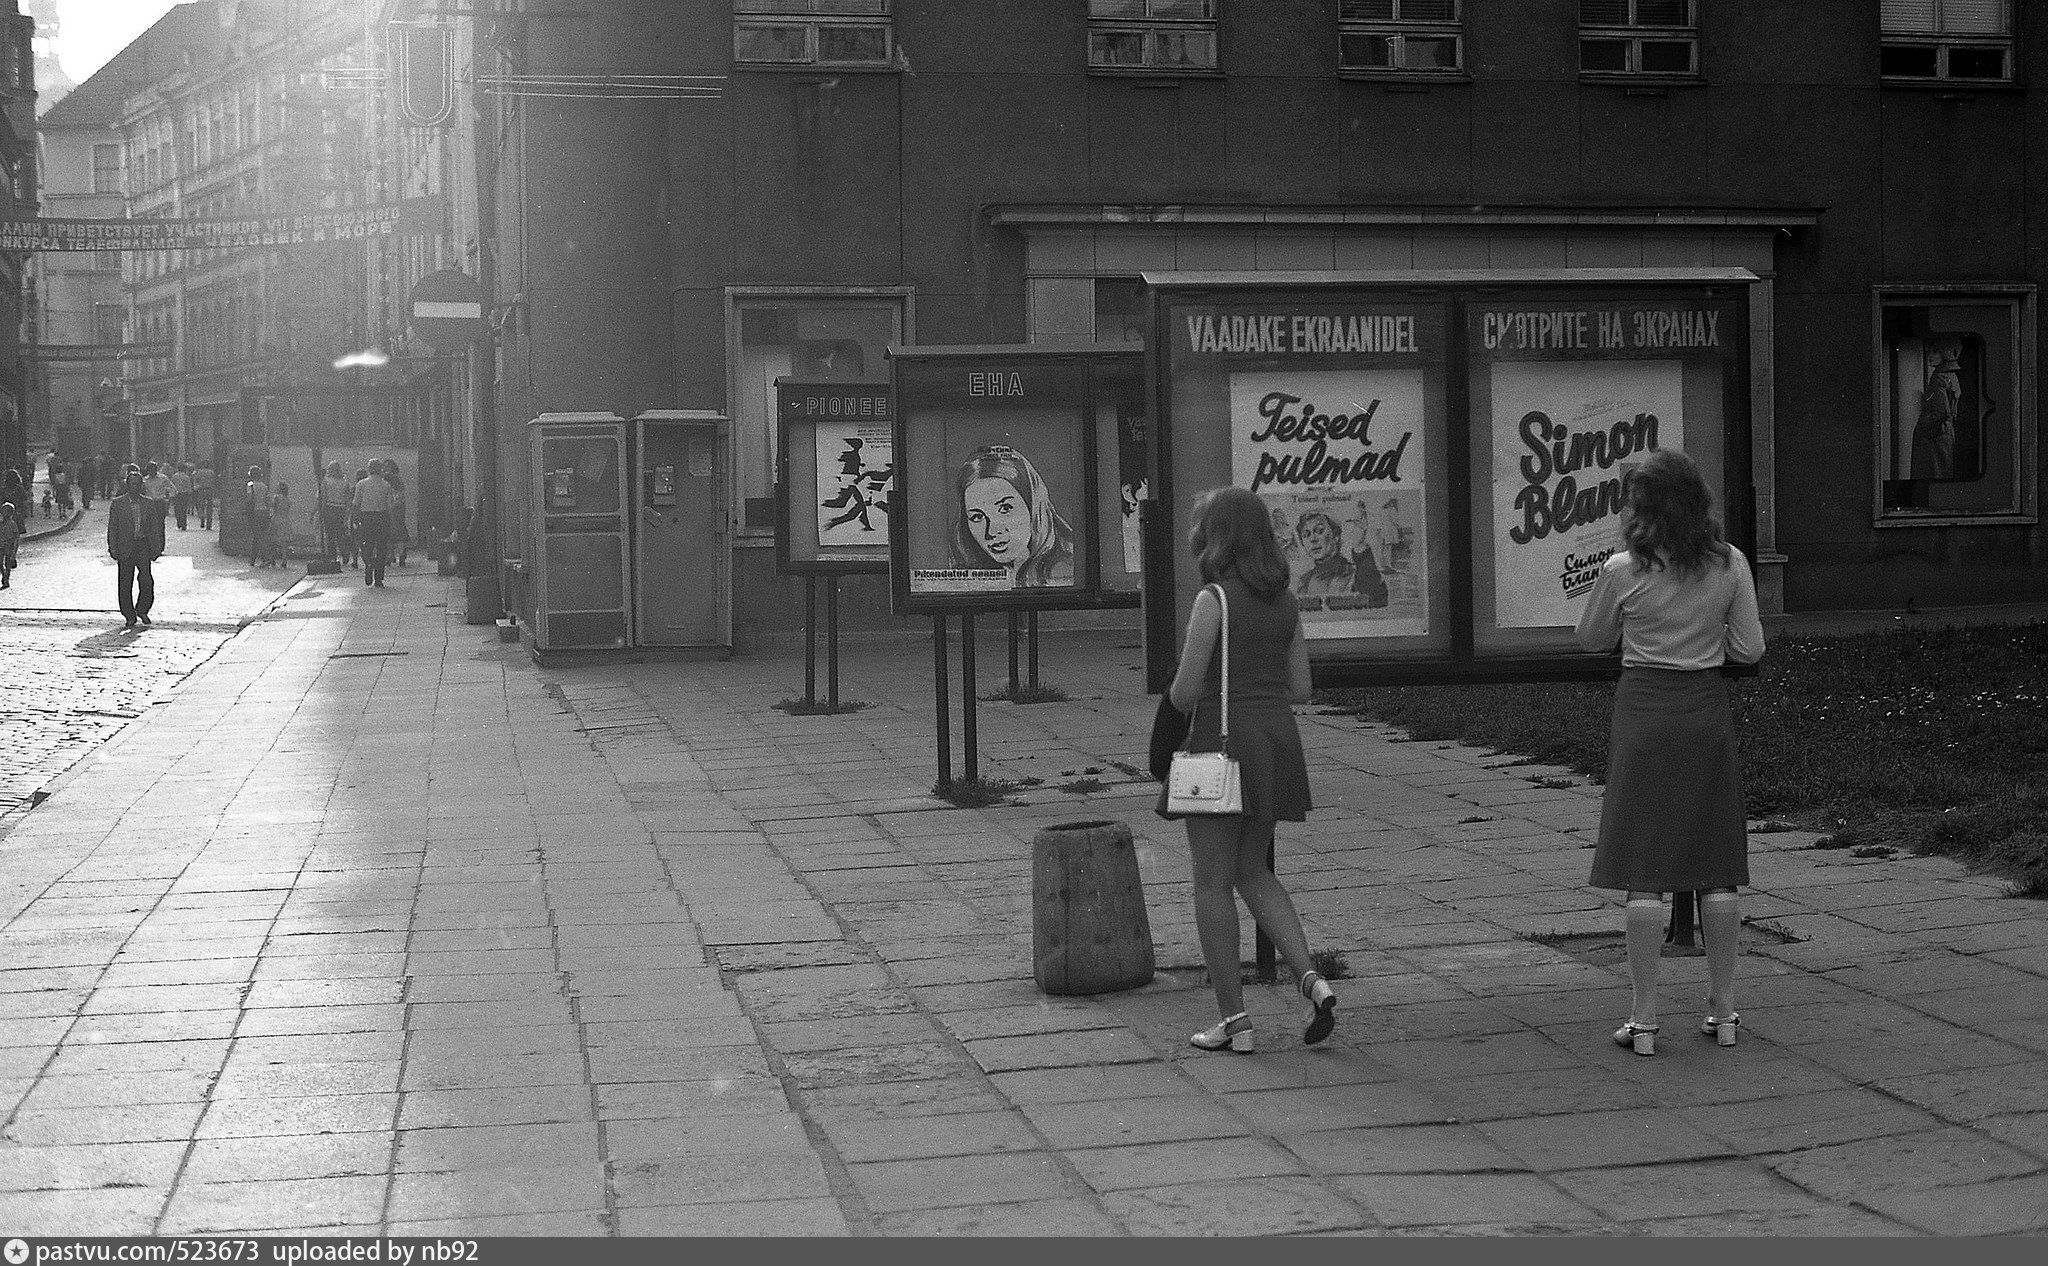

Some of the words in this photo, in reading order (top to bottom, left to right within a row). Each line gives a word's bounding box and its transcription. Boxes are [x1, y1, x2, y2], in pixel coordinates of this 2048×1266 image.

[0, 221, 42, 236] ЛЛИН
[48, 222, 161, 238] ПРИВЕТСТВУЕТ
[165, 220, 260, 238] УЧАСТНИКОВ
[0, 235, 61, 250] НКУРСА
[1187, 315, 1286, 352] VAADAKE
[1292, 315, 1418, 352] EKRAANIDEL
[1484, 311, 1588, 350] СМОТРИТЕ
[1599, 311, 1625, 349] НА
[1633, 310, 1720, 348] ЭКРАНАХ
[969, 372, 1024, 396] EHA
[806, 397, 892, 416] PIONEE
[1251, 392, 1382, 446] Teised
[1251, 432, 1413, 493] pulmad
[1519, 410, 1659, 485] Simon
